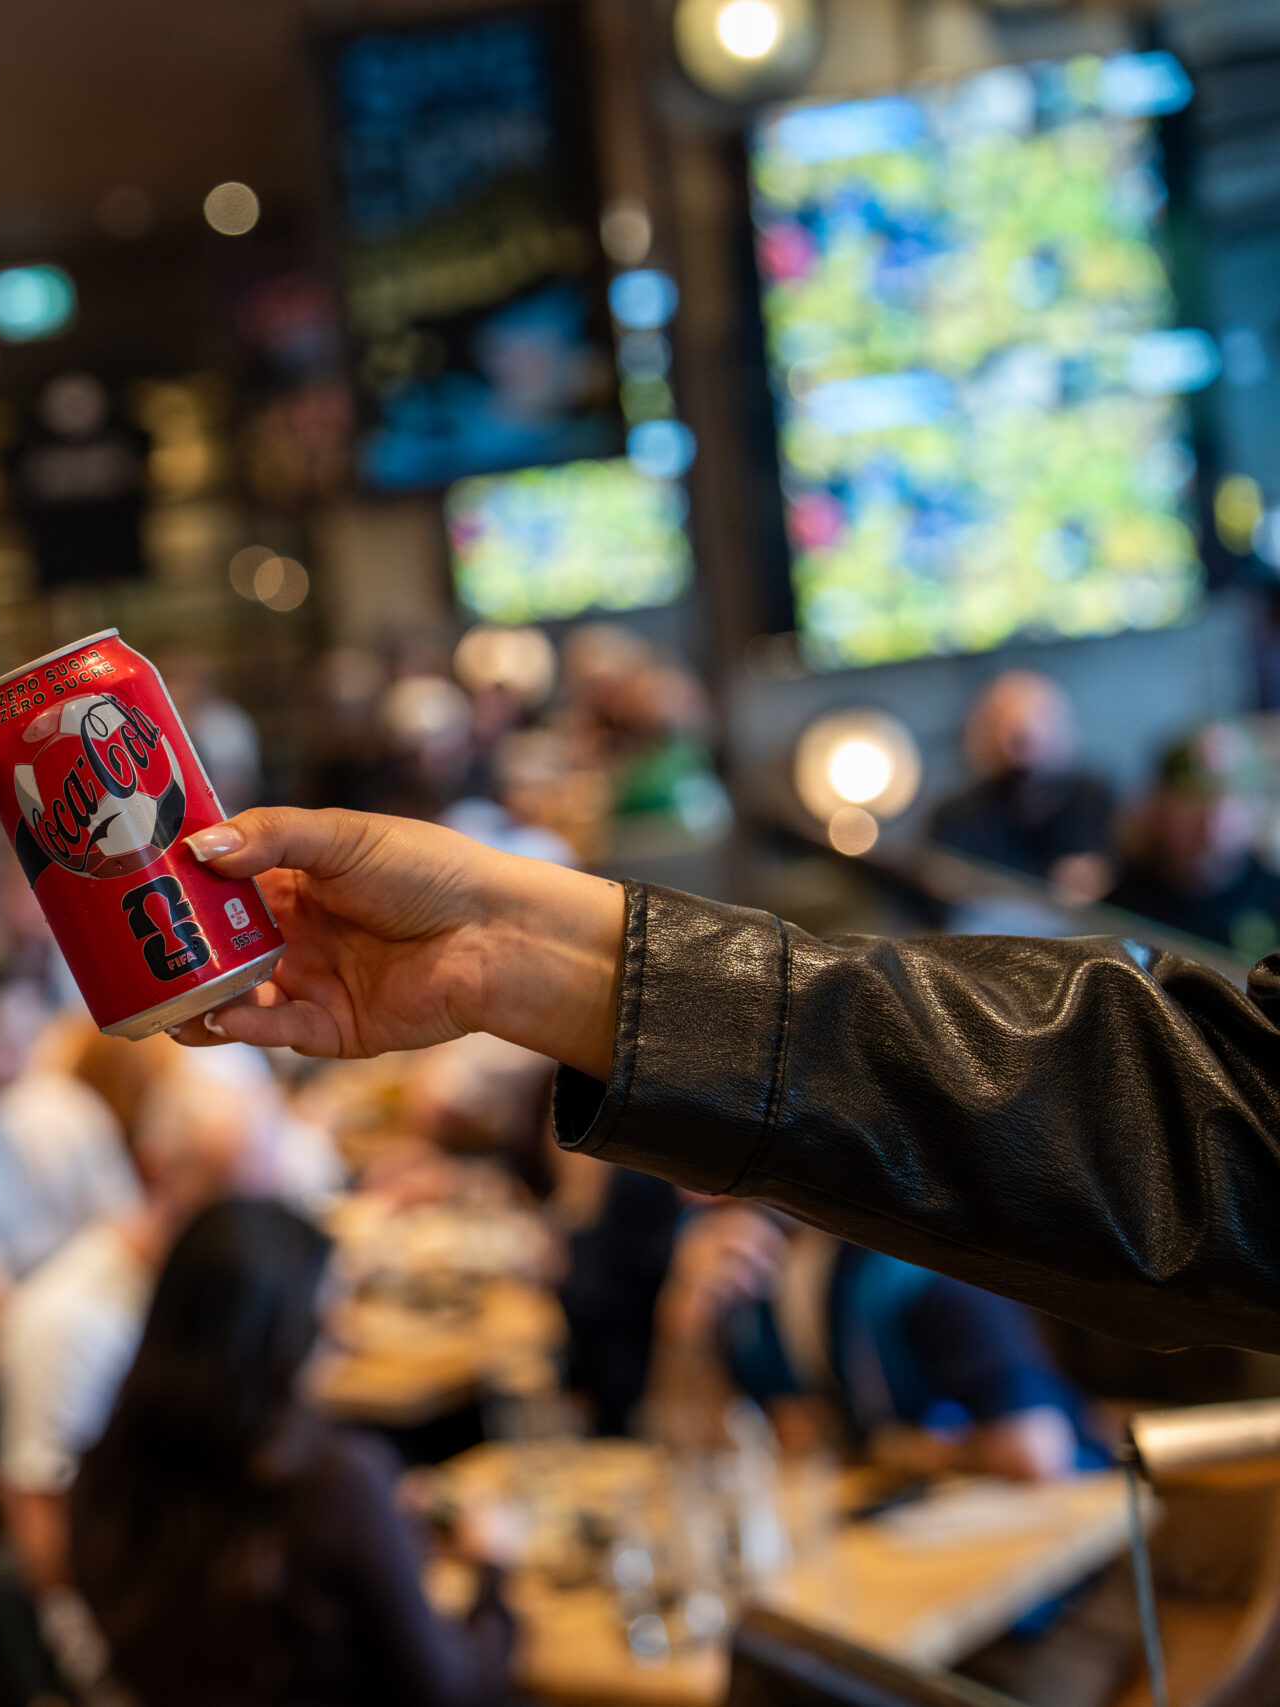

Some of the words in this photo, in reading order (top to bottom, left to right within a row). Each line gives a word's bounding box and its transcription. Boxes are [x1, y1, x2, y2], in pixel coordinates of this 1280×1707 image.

[45, 650, 104, 682] SUGAR
[0, 691, 46, 724] ZÉRO
[52, 662, 115, 696] SUCRE
[32, 693, 160, 872] Coca-Cola
[231, 931, 251, 951] 355
[249, 926, 264, 943] mL
[167, 950, 197, 971] FIFA
